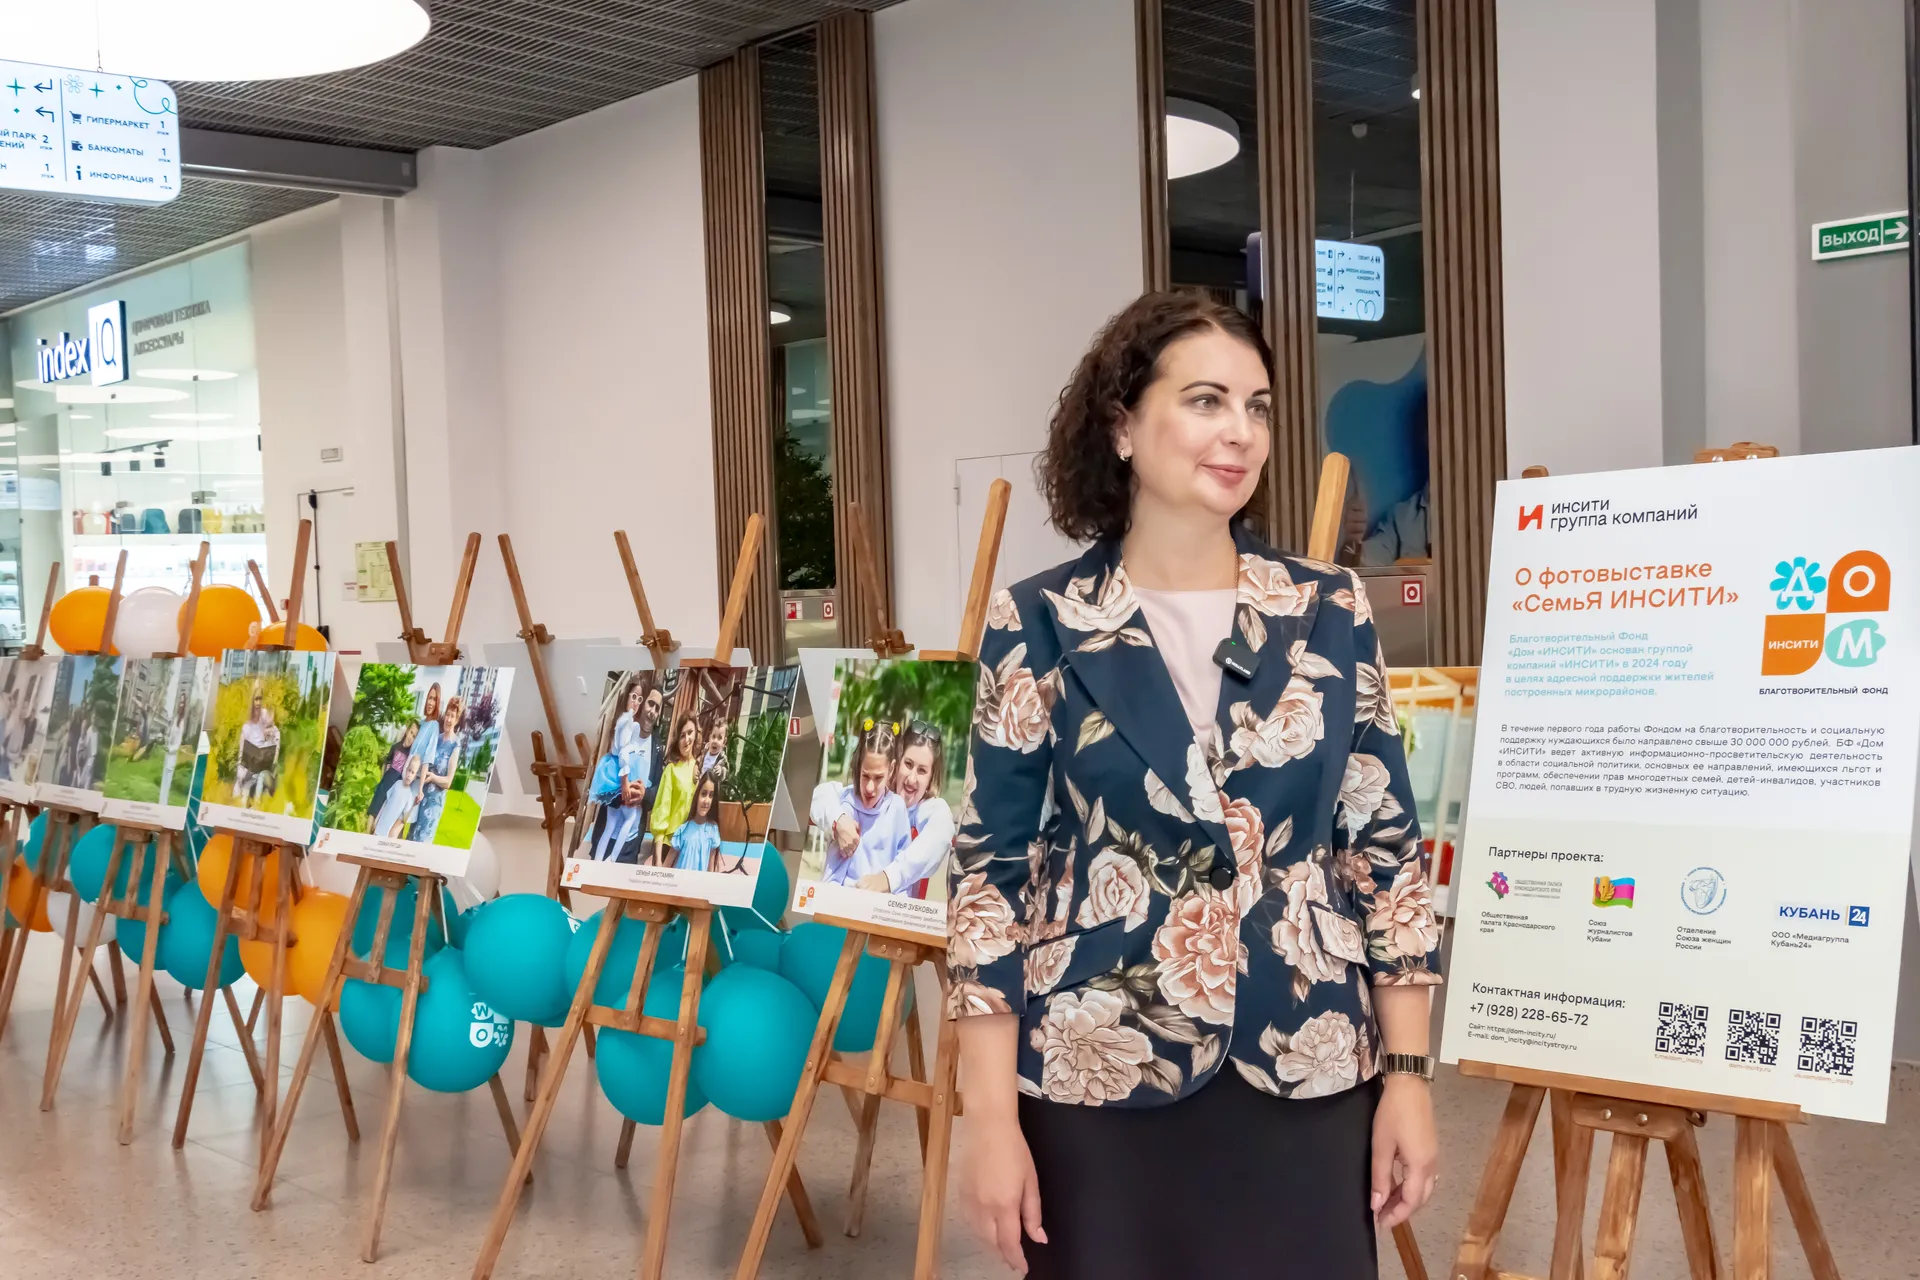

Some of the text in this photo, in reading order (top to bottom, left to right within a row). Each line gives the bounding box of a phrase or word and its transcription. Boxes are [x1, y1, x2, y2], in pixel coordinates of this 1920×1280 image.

[86, 116, 149, 129] ГИПЕРМАРКЕТ
[12, 131, 37, 140] ПАРК
[43, 135, 48, 143] 2
[88, 144, 143, 156] БАНКОМАТЫ
[90, 171, 153, 183] ИНФОРМАЦИЯ
[1822, 228, 1879, 247] ВЫХОД
[37, 332, 90, 383] index
[1552, 500, 1610, 515] ИНСИТИ
[1550, 504, 1697, 532] группа компаний
[1516, 563, 1712, 589] О фотовыставке
[1513, 586, 1739, 613] «СемьЯ ИНСИТИ»
[1510, 631, 1648, 644] Благотворительный Фонд
[1508, 644, 1693, 657] «Дом «ИНСИТИ» основан группой
[1768, 640, 1819, 649] ИНСИТИ
[1507, 661, 1556, 670] компаний
[1559, 659, 1619, 670] «ИНСИТИ»
[1632, 658, 1659, 668] 2024
[1663, 659, 1688, 670] году
[1514, 675, 1544, 685] целях
[1546, 672, 1598, 683] адресной
[1600, 672, 1662, 684] поддержки
[1665, 670, 1714, 682] жителей
[1504, 686, 1657, 697] построенных микрорайонов.
[1759, 686, 1888, 696] БЛАГОТВОРИТЕЛЬНЫЙ ФОНД
[1699, 726, 1807, 734] благотворительность
[1821, 727, 1885, 736] социальную
[1746, 738, 1765, 746] 000
[1769, 738, 1789, 746] 000
[1792, 739, 1831, 748] рублей.
[1857, 739, 1884, 748] «Дом
[1630, 750, 1803, 760] информационно-просветительскую
[1810, 753, 1882, 761] деятельность
[1708, 764, 1774, 772] направлений,
[1778, 765, 1838, 773] имеющихся
[1496, 771, 1541, 779] программ,
[1727, 776, 1816, 785] детей-инвалидов,
[1604, 786, 1642, 794] трудную
[1488, 847, 1603, 862] Партнеры проекта:
[888, 900, 938, 914] СЕМЬЯ ЗУБКОВЫХ
[1481, 912, 1528, 920] Общественная
[1779, 906, 1866, 924] КУБАНЬ 24
[1503, 921, 1555, 930] Краснодарского
[1677, 926, 1716, 935] Отделение
[1588, 928, 1632, 937] журналистов
[1792, 933, 1849, 944] «Медиагруппа
[1771, 940, 1811, 949] Кубань24»
[1472, 983, 1625, 1008] Контактная информация:
[1470, 1003, 1588, 1026] +7 (928) 228-65-72
[1469, 1022, 1485, 1031] Сайт:
[1468, 1031, 1489, 1039] E-mail:
